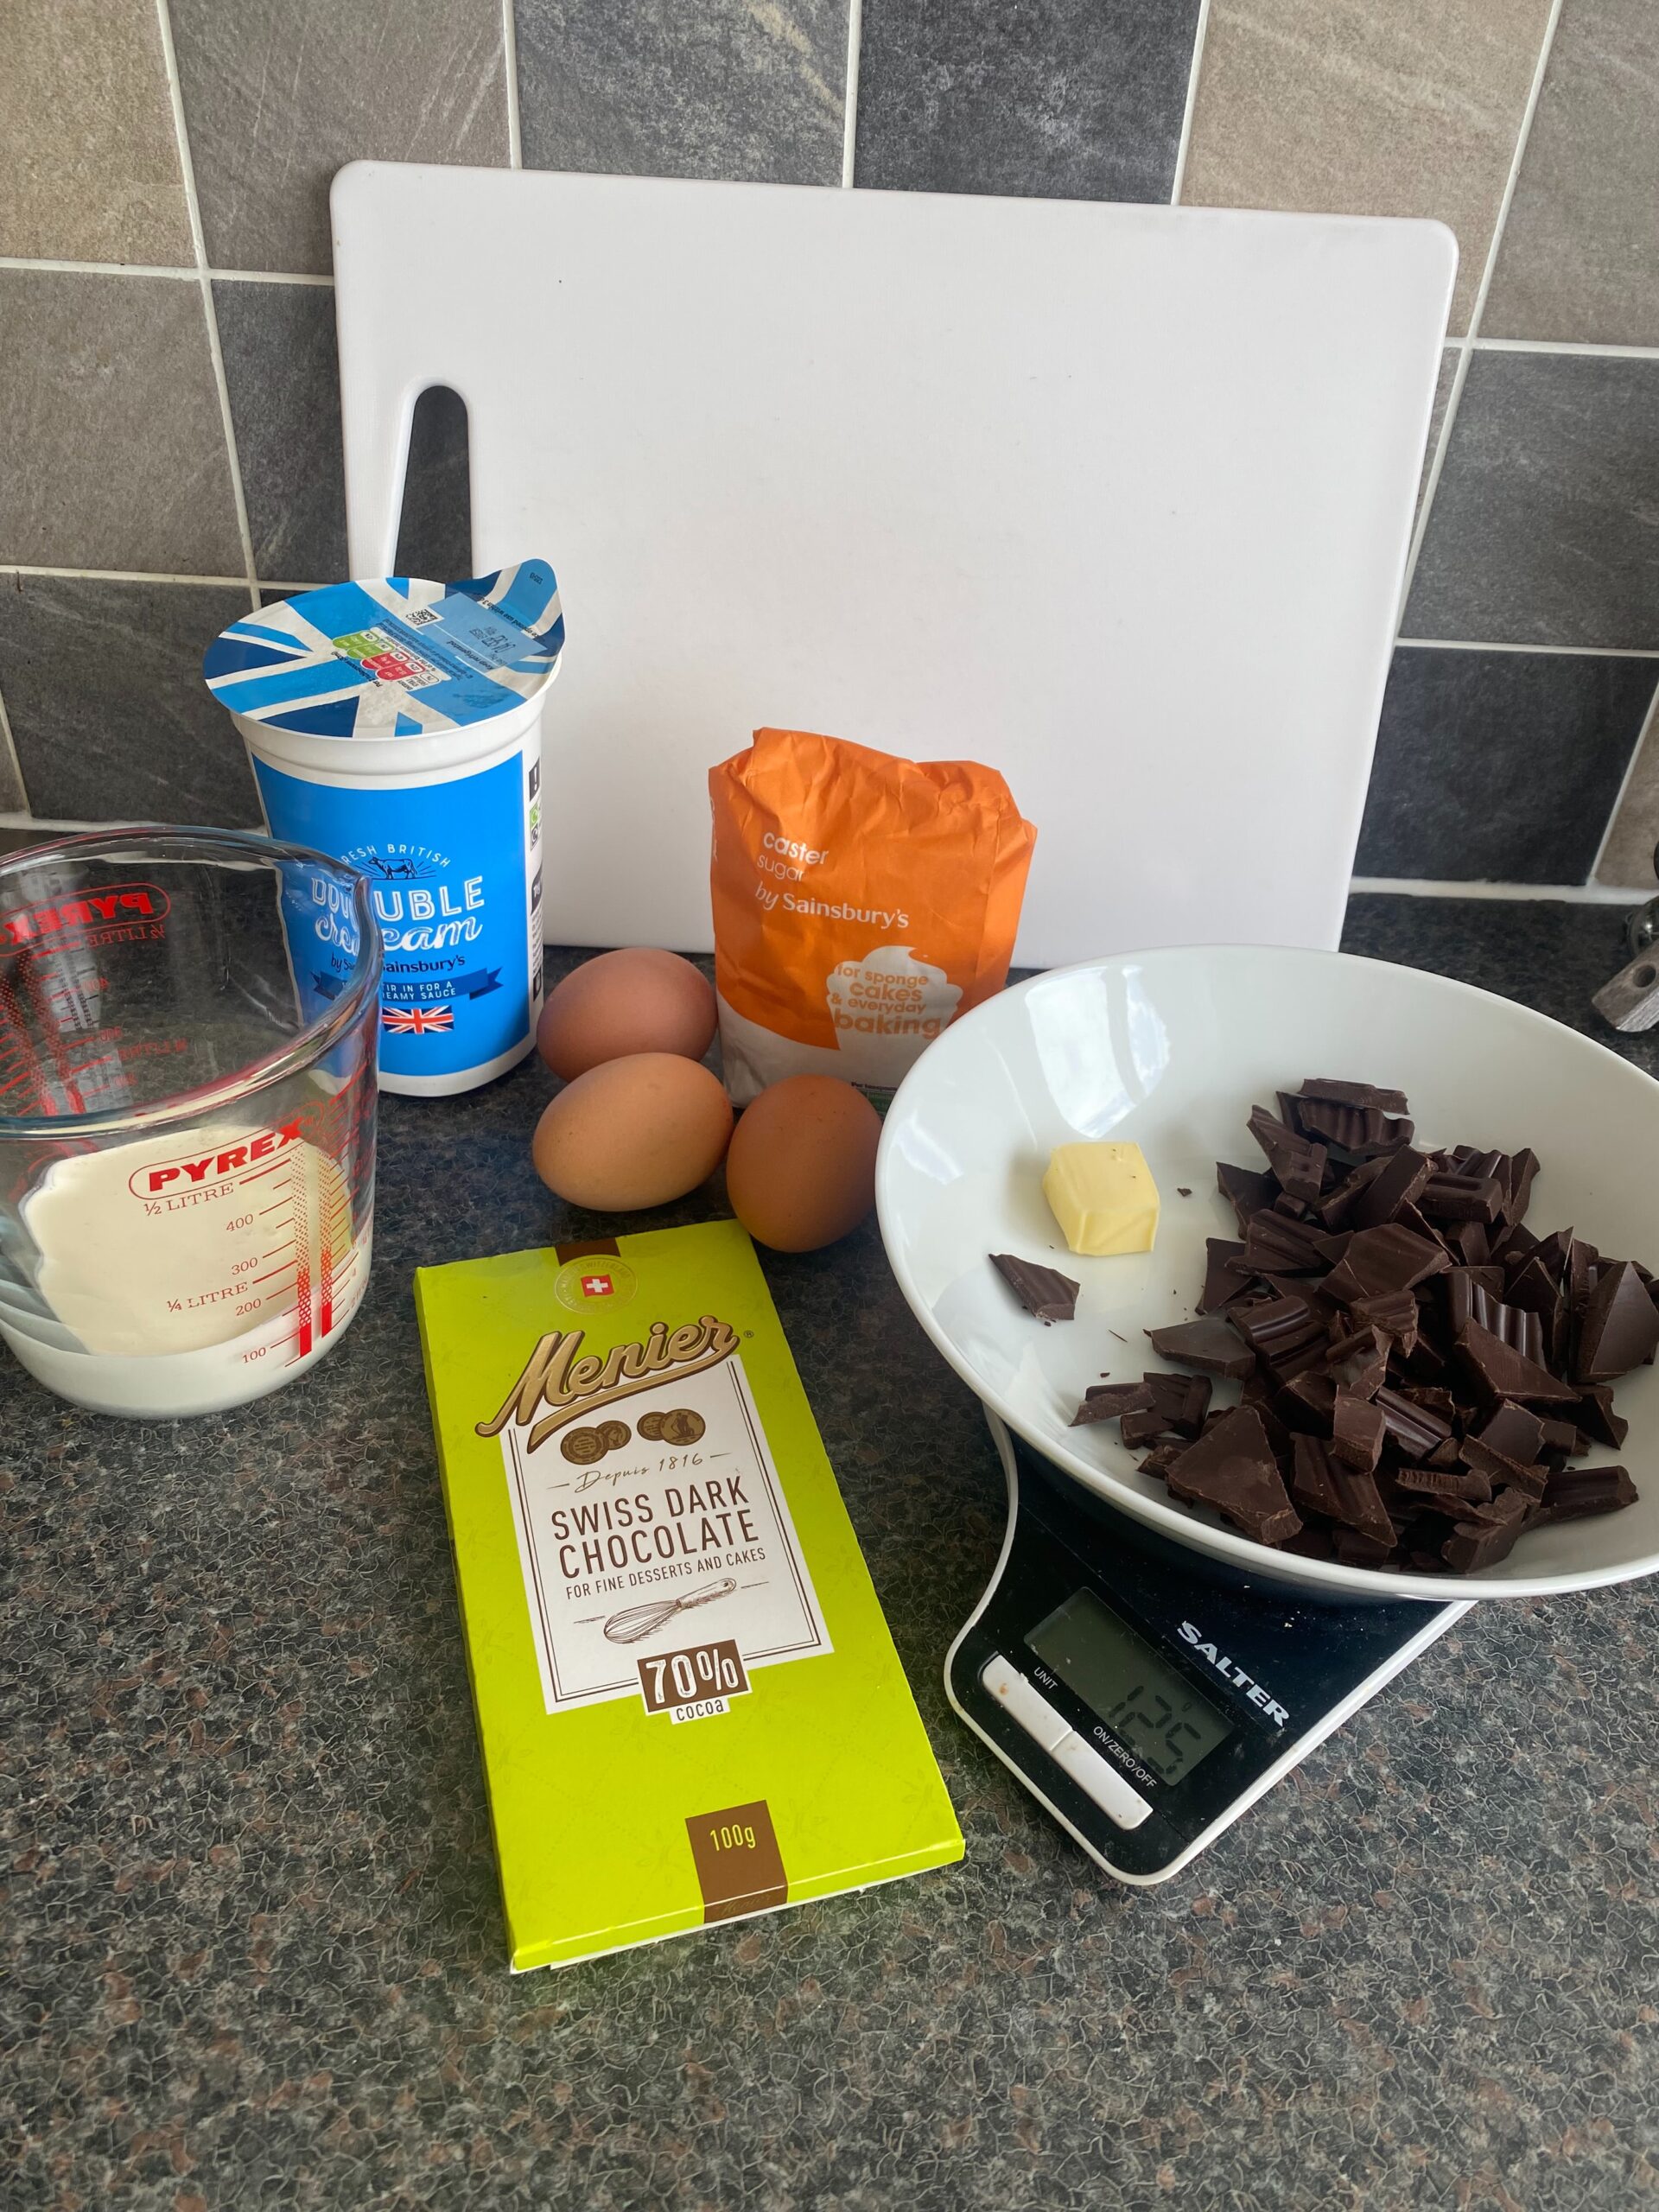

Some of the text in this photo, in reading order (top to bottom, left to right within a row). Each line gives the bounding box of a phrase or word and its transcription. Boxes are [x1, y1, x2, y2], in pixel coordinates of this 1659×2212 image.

[340, 843, 451, 868] RESH BRITISH
[762, 831, 829, 865] caster
[757, 853, 804, 881] sugar
[754, 880, 909, 929] by Sainsbury's
[420, 982, 440, 992] FOR
[837, 963, 929, 989] for sponge
[421, 988, 456, 1000] SAUCE
[830, 992, 926, 1014] & everyday
[849, 982, 923, 1002] cakes
[834, 1007, 942, 1040] baking
[149, 1116, 303, 1192] PYREX
[166, 1182, 234, 1211] LITRE
[226, 1213, 254, 1232] 400
[231, 1256, 258, 1276] 300
[188, 1281, 248, 1310] LITRE
[235, 1298, 262, 1317] 200
[242, 1346, 267, 1364] 100
[474, 1314, 741, 1453] Menier
[575, 1452, 703, 1493] Depuis 1816
[551, 1475, 749, 1541] SWISS DARK
[559, 1509, 760, 1579] CHOCOLATE
[566, 1547, 766, 1600] FOR FINE DESSERTS AND CAKES
[645, 1648, 740, 1705] 70%
[1033, 1666, 1058, 1691] UNIT
[1177, 1620, 1290, 1728] SALTER
[676, 1699, 725, 1721] cocoa
[1109, 1684, 1202, 1775] 125
[1092, 1725, 1158, 1789] ON/ZERO/OFF
[709, 1824, 756, 1852] 100g
